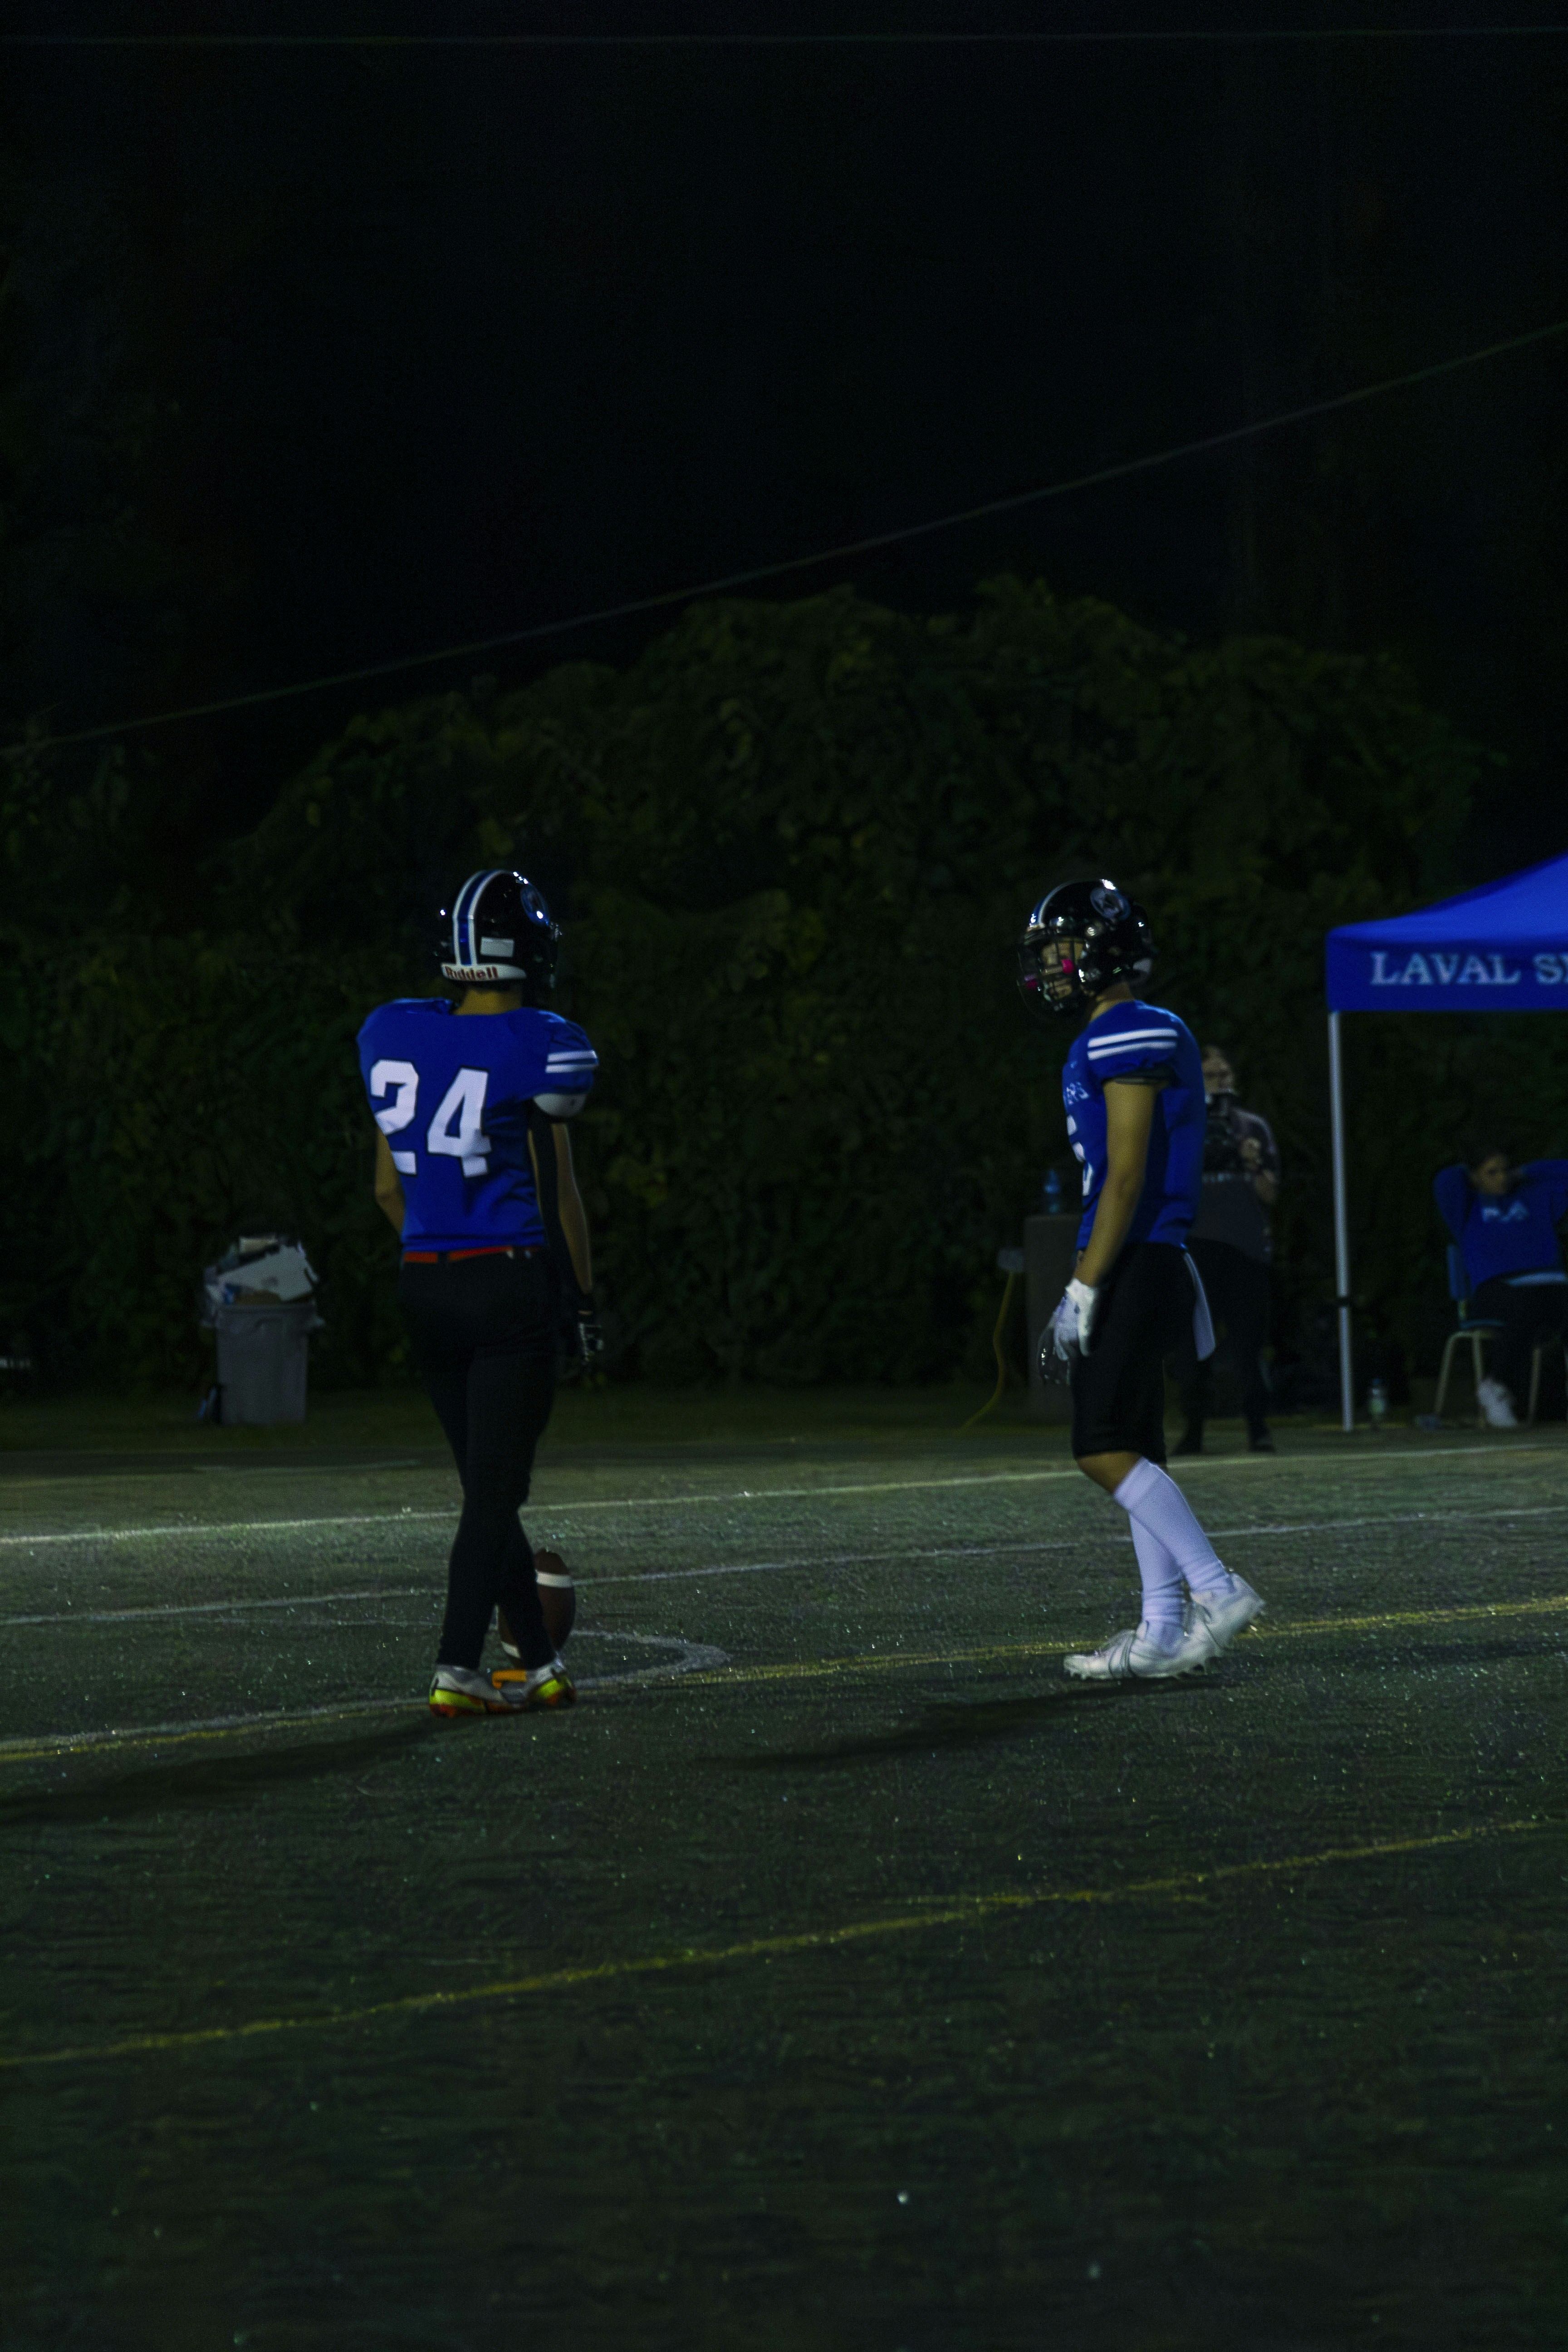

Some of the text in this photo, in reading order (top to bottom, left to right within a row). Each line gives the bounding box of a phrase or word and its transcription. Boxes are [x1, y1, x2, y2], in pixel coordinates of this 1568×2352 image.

[445, 965, 498, 980] Riddell
[1370, 952, 1568, 985] LAVAL S
[370, 1059, 492, 1178] 24
